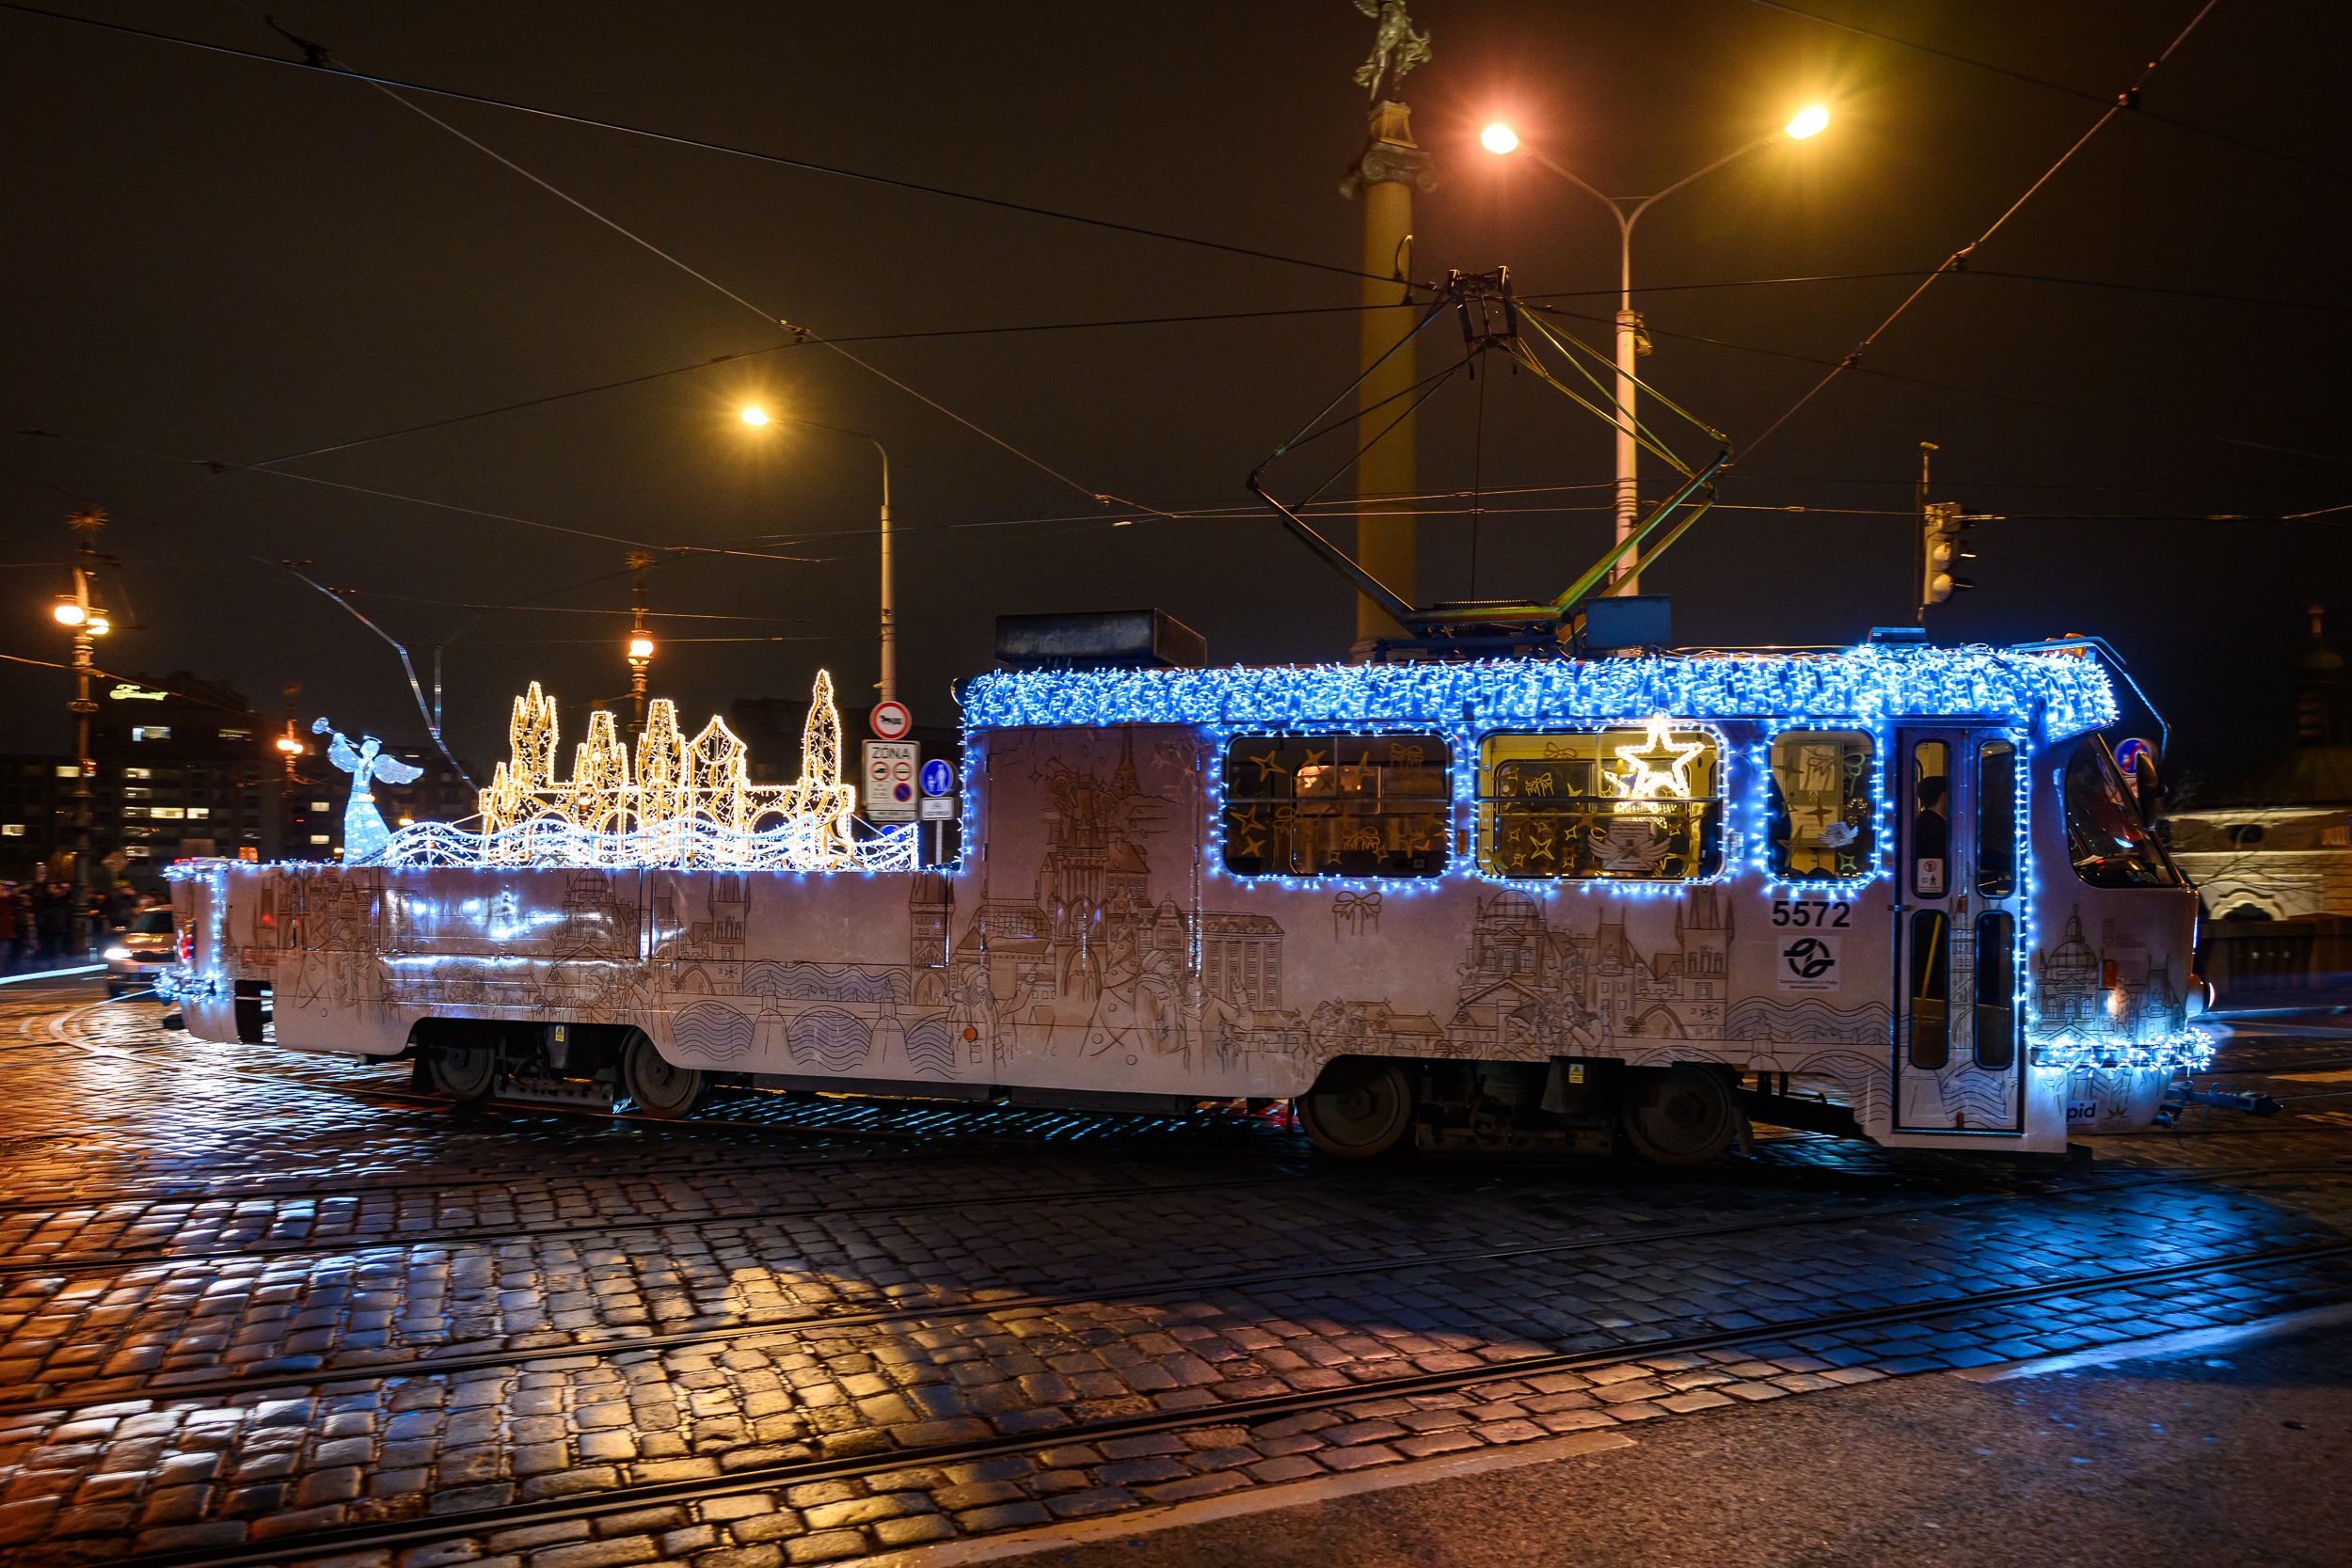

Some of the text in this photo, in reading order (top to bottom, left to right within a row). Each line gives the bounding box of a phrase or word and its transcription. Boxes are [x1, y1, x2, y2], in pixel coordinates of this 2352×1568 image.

[872, 746, 912, 760] ZONA
[1772, 900, 1851, 927] 5572
[2066, 1102, 2096, 1122] pid
